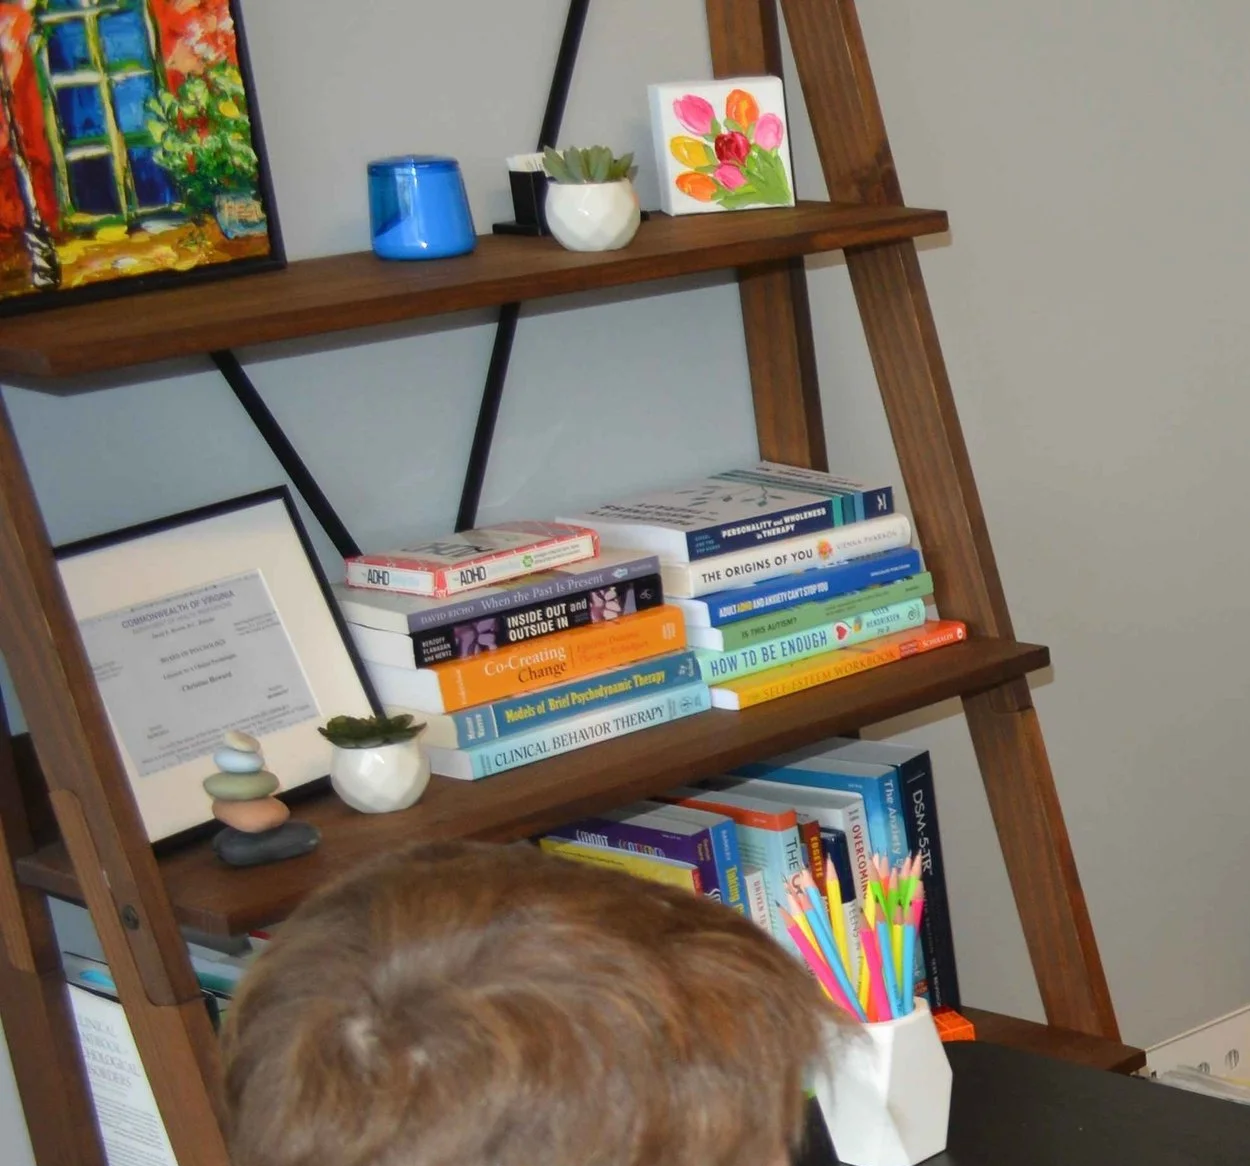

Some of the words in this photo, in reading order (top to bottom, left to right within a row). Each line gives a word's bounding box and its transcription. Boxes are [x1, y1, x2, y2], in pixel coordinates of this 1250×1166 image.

[721, 519, 772, 539] PERSONALITY
[773, 518, 784, 527] and
[784, 507, 827, 524] WHOLENESS
[762, 524, 796, 538] THERAPY
[367, 568, 390, 586] ADHD
[460, 566, 487, 586] ADHD
[702, 570, 722, 584] THE
[725, 560, 771, 579] ORIGINS
[774, 555, 789, 567] OF
[791, 548, 814, 563] YOU
[481, 597, 511, 611] When
[513, 589, 532, 603] the
[533, 586, 553, 600] Past
[556, 582, 566, 593] Is
[567, 573, 605, 591] Present
[719, 604, 737, 618] ADULT
[753, 597, 765, 609] AND
[765, 591, 788, 606] ANXIETY
[803, 583, 817, 597] STOP
[817, 581, 829, 593] YOU
[421, 611, 447, 625] DAVID
[507, 605, 543, 629] INSIDE
[546, 603, 567, 619] OUT
[569, 598, 588, 613] and
[508, 620, 555, 643] OUTSIDE
[557, 616, 569, 630] IN
[741, 630, 749, 639] IS
[750, 625, 766, 636] THIS
[767, 617, 797, 631] AUTISM?
[484, 645, 567, 678] Co-Creating
[710, 655, 739, 677] HOW
[741, 649, 758, 669] TO
[761, 644, 777, 662] BE
[780, 631, 828, 658] ENOUGH
[518, 660, 568, 685] Change
[505, 704, 536, 724] Models
[536, 700, 546, 714] of
[547, 692, 571, 712] Brief
[570, 679, 633, 707] Psychodynamic
[632, 670, 666, 688] Therapy
[494, 740, 550, 768] CLINICAL
[552, 721, 612, 750] BEHAVIOR
[613, 704, 665, 731] THERAPY
[884, 779, 894, 804] The
[887, 806, 902, 854] Anxiety
[912, 789, 932, 873] DSM-5-TR
[785, 836, 800, 871] THE
[726, 864, 740, 903] Taking
